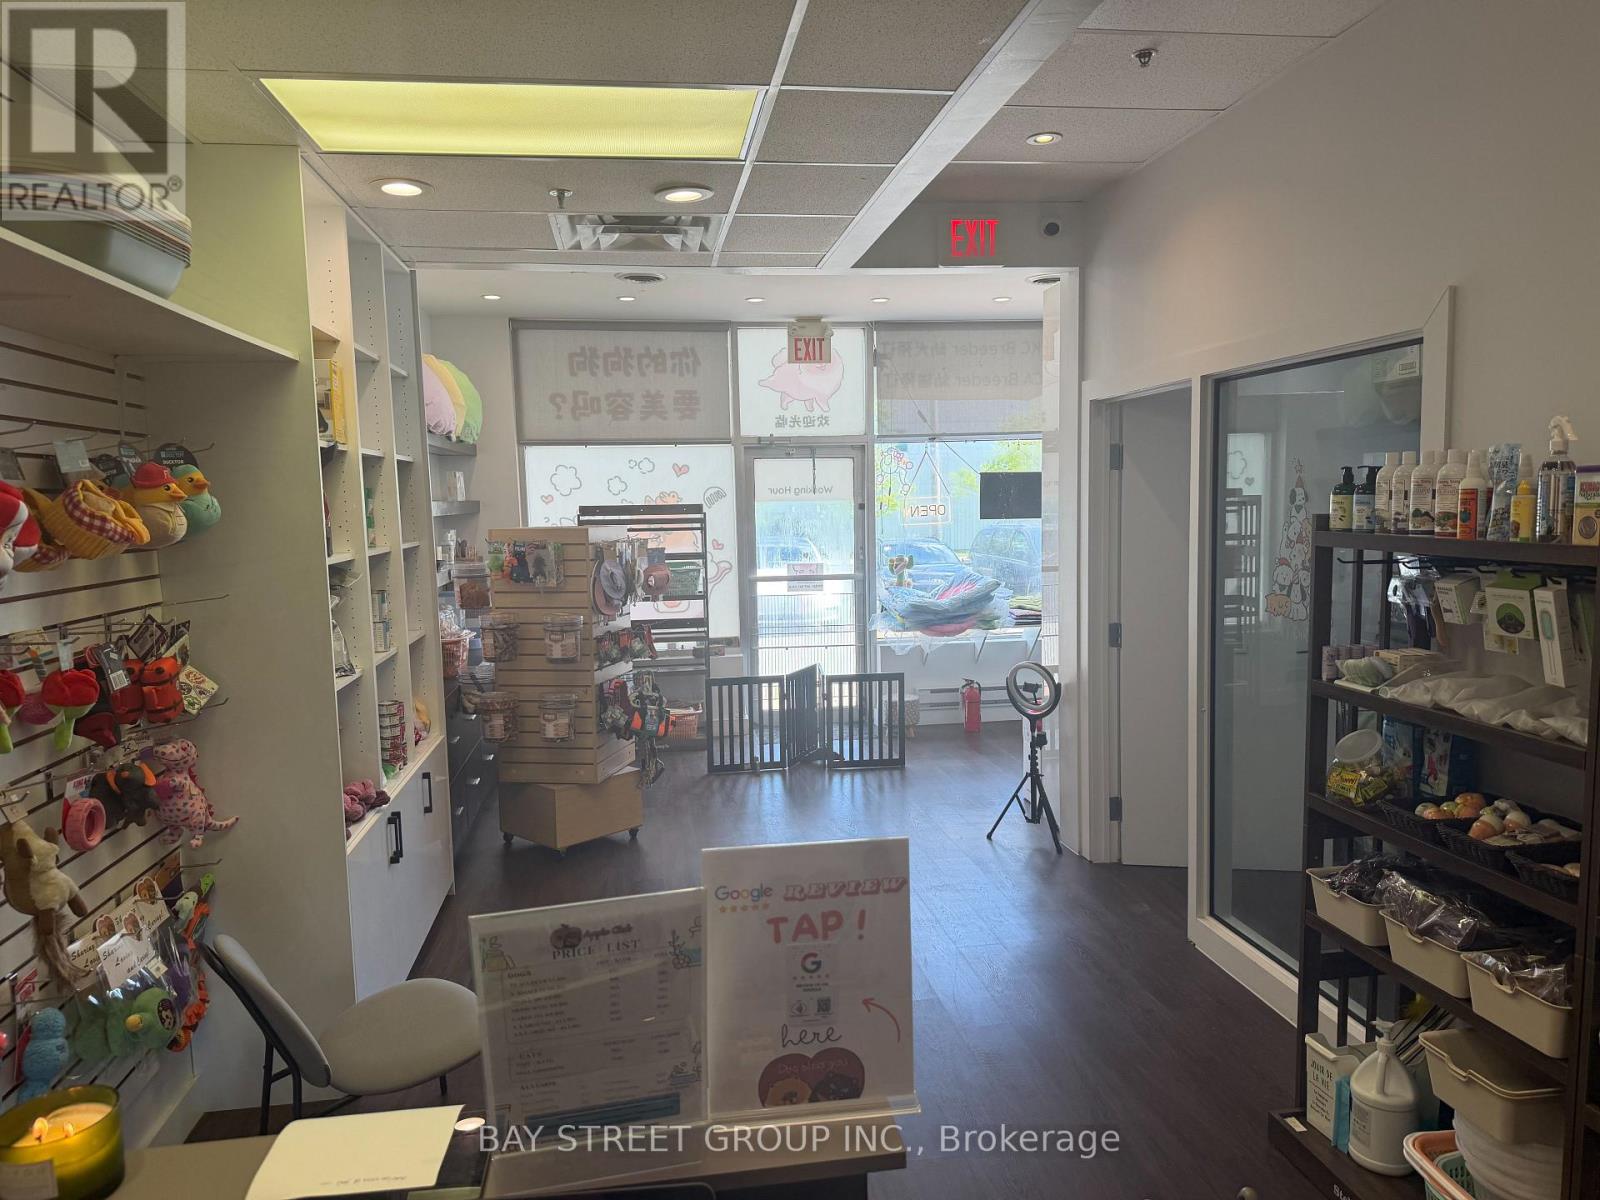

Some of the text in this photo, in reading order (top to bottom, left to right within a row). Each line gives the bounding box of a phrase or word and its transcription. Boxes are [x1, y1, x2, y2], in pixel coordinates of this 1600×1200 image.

[951, 218, 1000, 257] EXIT
[794, 337, 825, 362] EXIT
[714, 876, 907, 903] Google REVIEW
[766, 910, 844, 944] TAP
[552, 939, 641, 960] PRICE LIST
[800, 952, 822, 973] G
[781, 1023, 843, 1048] here
